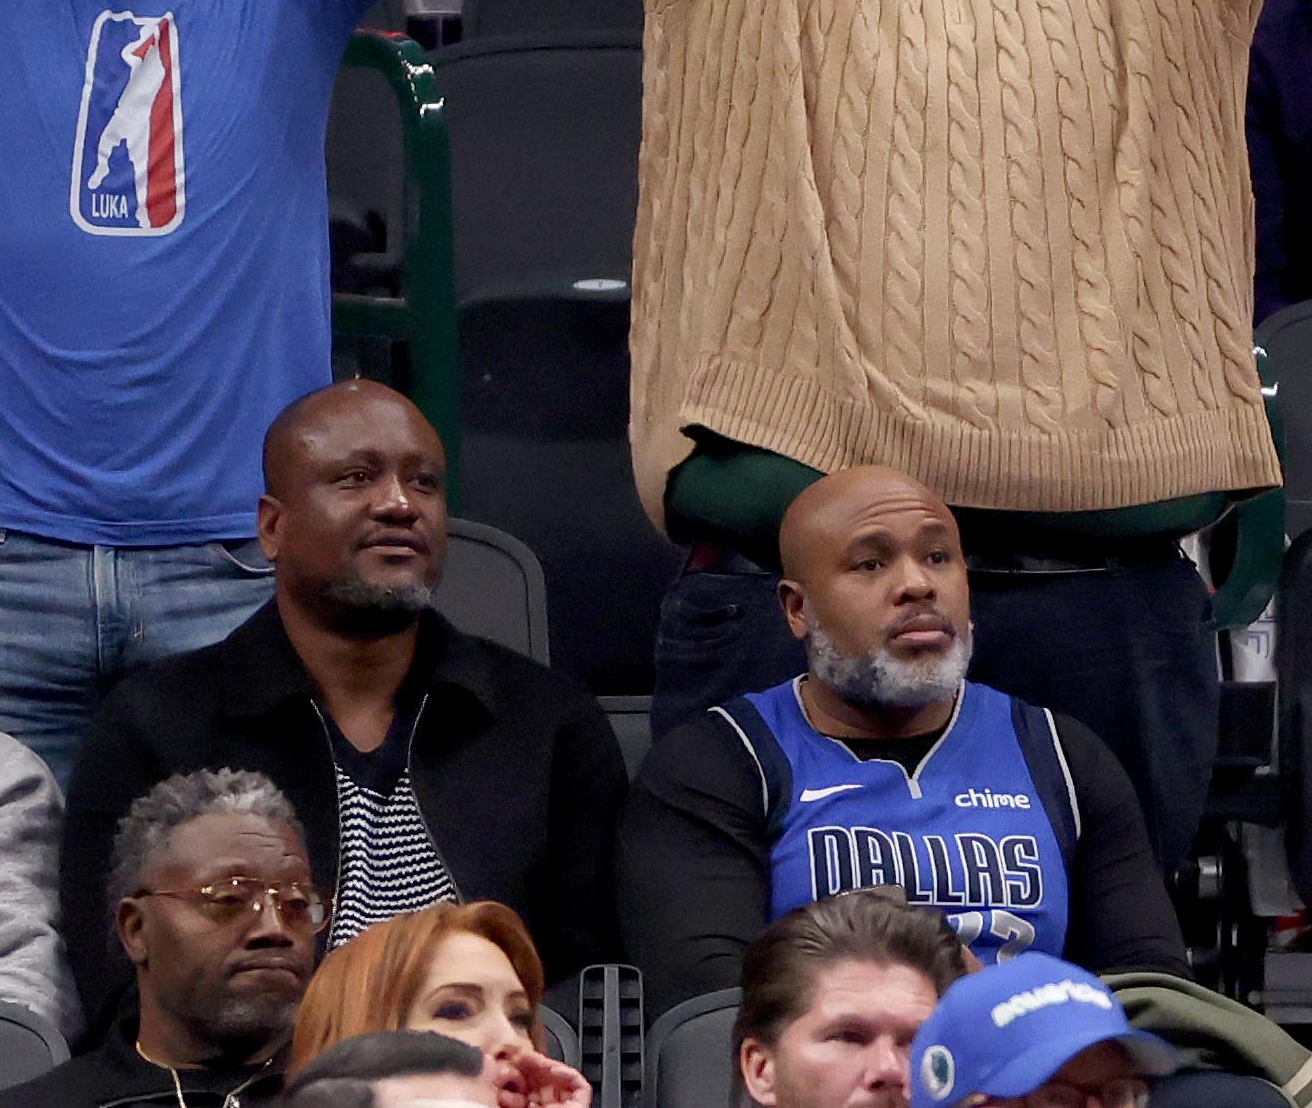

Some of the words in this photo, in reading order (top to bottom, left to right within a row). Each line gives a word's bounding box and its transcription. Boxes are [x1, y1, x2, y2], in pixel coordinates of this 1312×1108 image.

[92, 193, 129, 218] LUKA
[954, 788, 1031, 809] chime
[807, 825, 1044, 909] DALLAS
